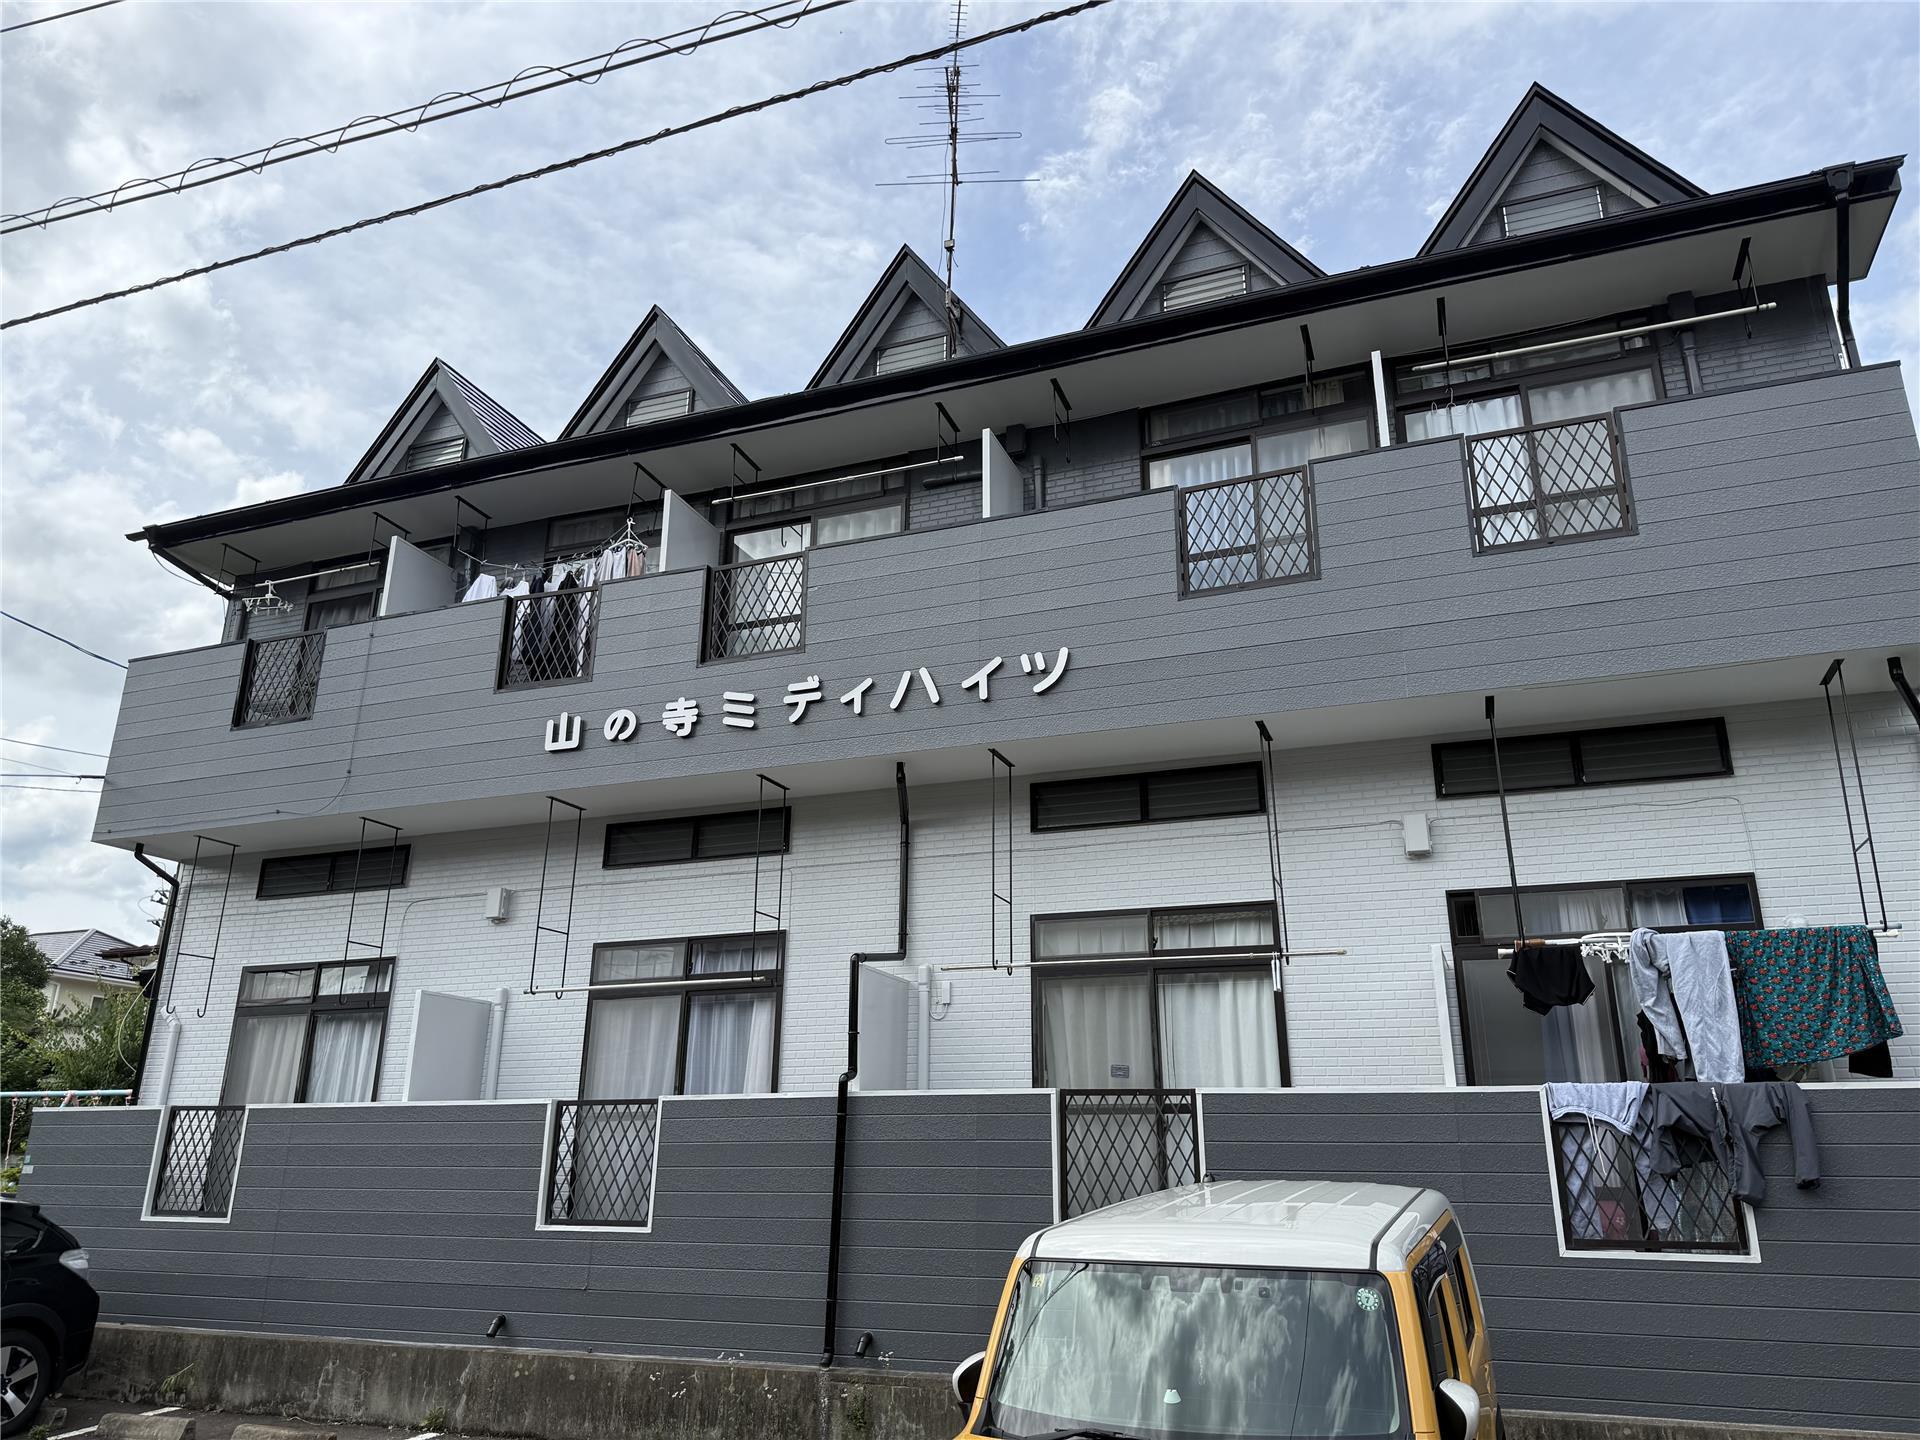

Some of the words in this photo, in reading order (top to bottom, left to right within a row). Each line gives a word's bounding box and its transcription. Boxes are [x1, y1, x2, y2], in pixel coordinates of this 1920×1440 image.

[545, 647, 1069, 752] 山の寺ミディハイツ
